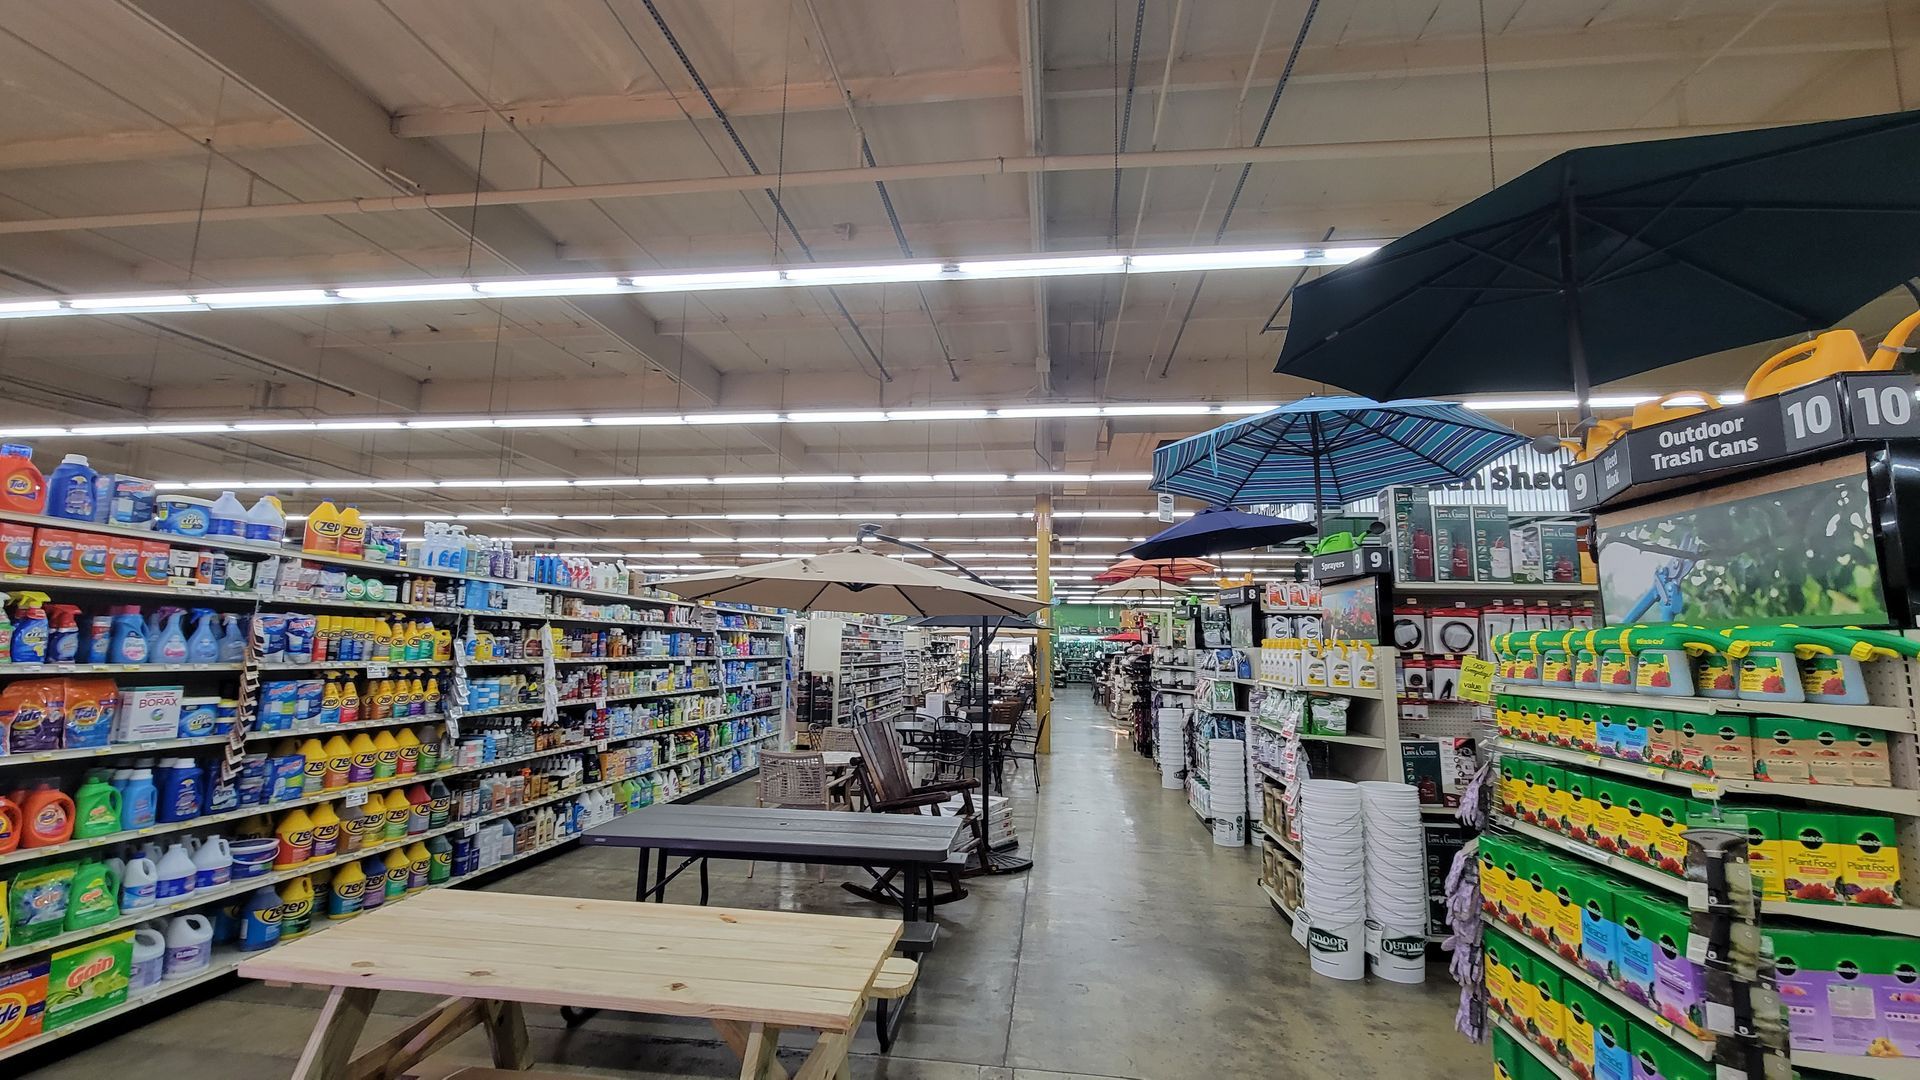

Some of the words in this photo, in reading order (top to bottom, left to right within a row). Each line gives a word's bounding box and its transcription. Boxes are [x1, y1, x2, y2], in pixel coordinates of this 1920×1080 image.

[1858, 386, 1911, 425] 10
[1787, 395, 1832, 439] 10
[1659, 417, 1744, 449] Outdoor
[1651, 445, 1704, 471] Trash
[1708, 436, 1759, 459] Cans
[9, 479, 28, 489] Tide
[1492, 463, 1567, 491] Shed
[1574, 473, 1588, 500] 9
[1321, 560, 1345, 572] Sprayers
[1354, 553, 1360, 569] 9
[1370, 551, 1382, 568] 9
[1248, 588, 1257, 600] 8
[1192, 607, 1198, 615] 7
[139, 698, 178, 709] BORAX
[295, 830, 312, 842] ze
[1788, 856, 1813, 868] Plant
[1814, 858, 1837, 869] Food
[1847, 860, 1871, 872] Plant
[1872, 862, 1895, 873] Food
[268, 907, 283, 920] ze
[1311, 933, 1346, 951] TDOOR
[1383, 939, 1424, 953] OUTDOO
[67, 956, 115, 990] Gain
